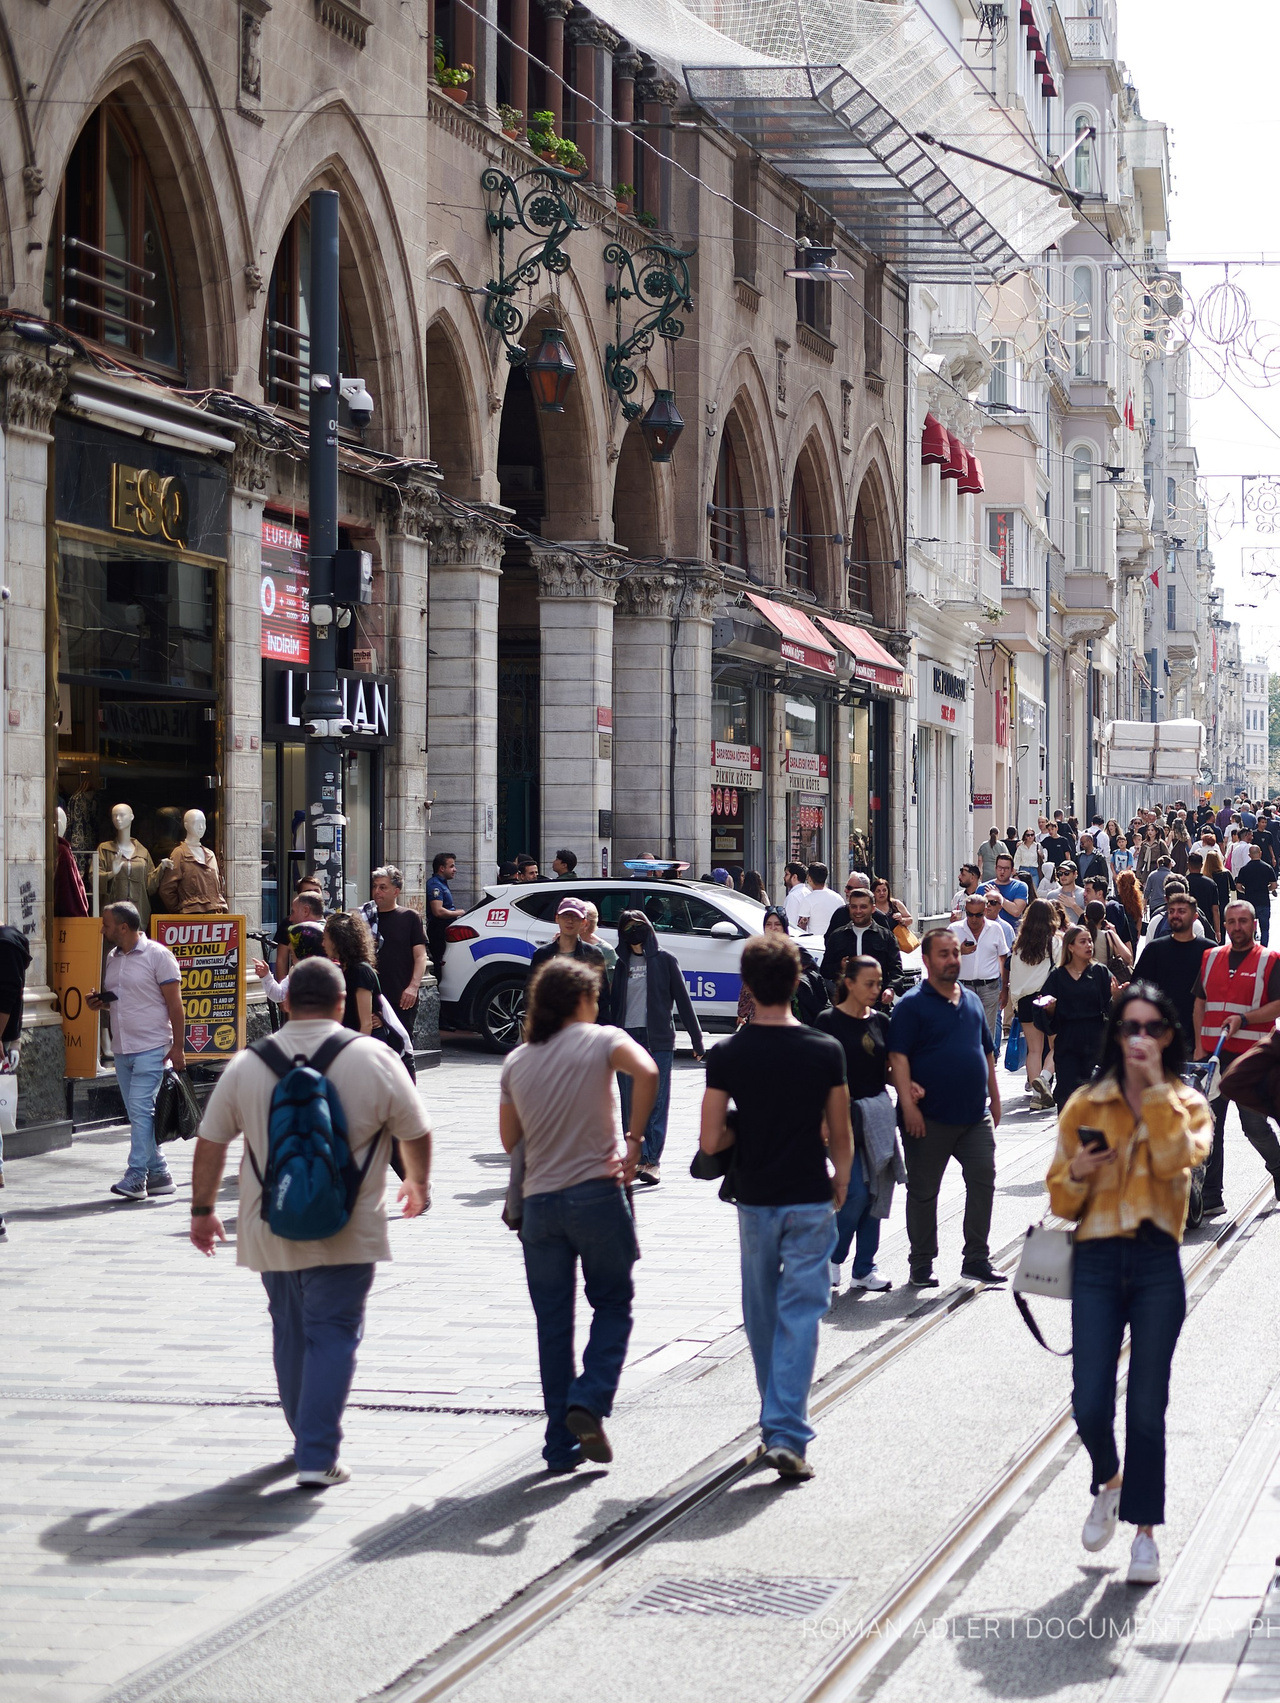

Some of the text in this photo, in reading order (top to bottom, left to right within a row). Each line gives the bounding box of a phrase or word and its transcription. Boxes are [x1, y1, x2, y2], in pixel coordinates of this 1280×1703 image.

[112, 462, 188, 550] ESQ
[265, 527, 302, 549] LUFIAN
[267, 631, 300, 656] İNDİRİM
[288, 670, 389, 737] LIAN
[715, 768, 752, 786] PİKNİK KÖFTE
[789, 774, 820, 790] PİKNİK KÖFTE
[491, 911, 506, 920] 112
[165, 923, 233, 945] OUTLET
[172, 944, 220, 956] REYONU
[684, 976, 716, 998] LİS
